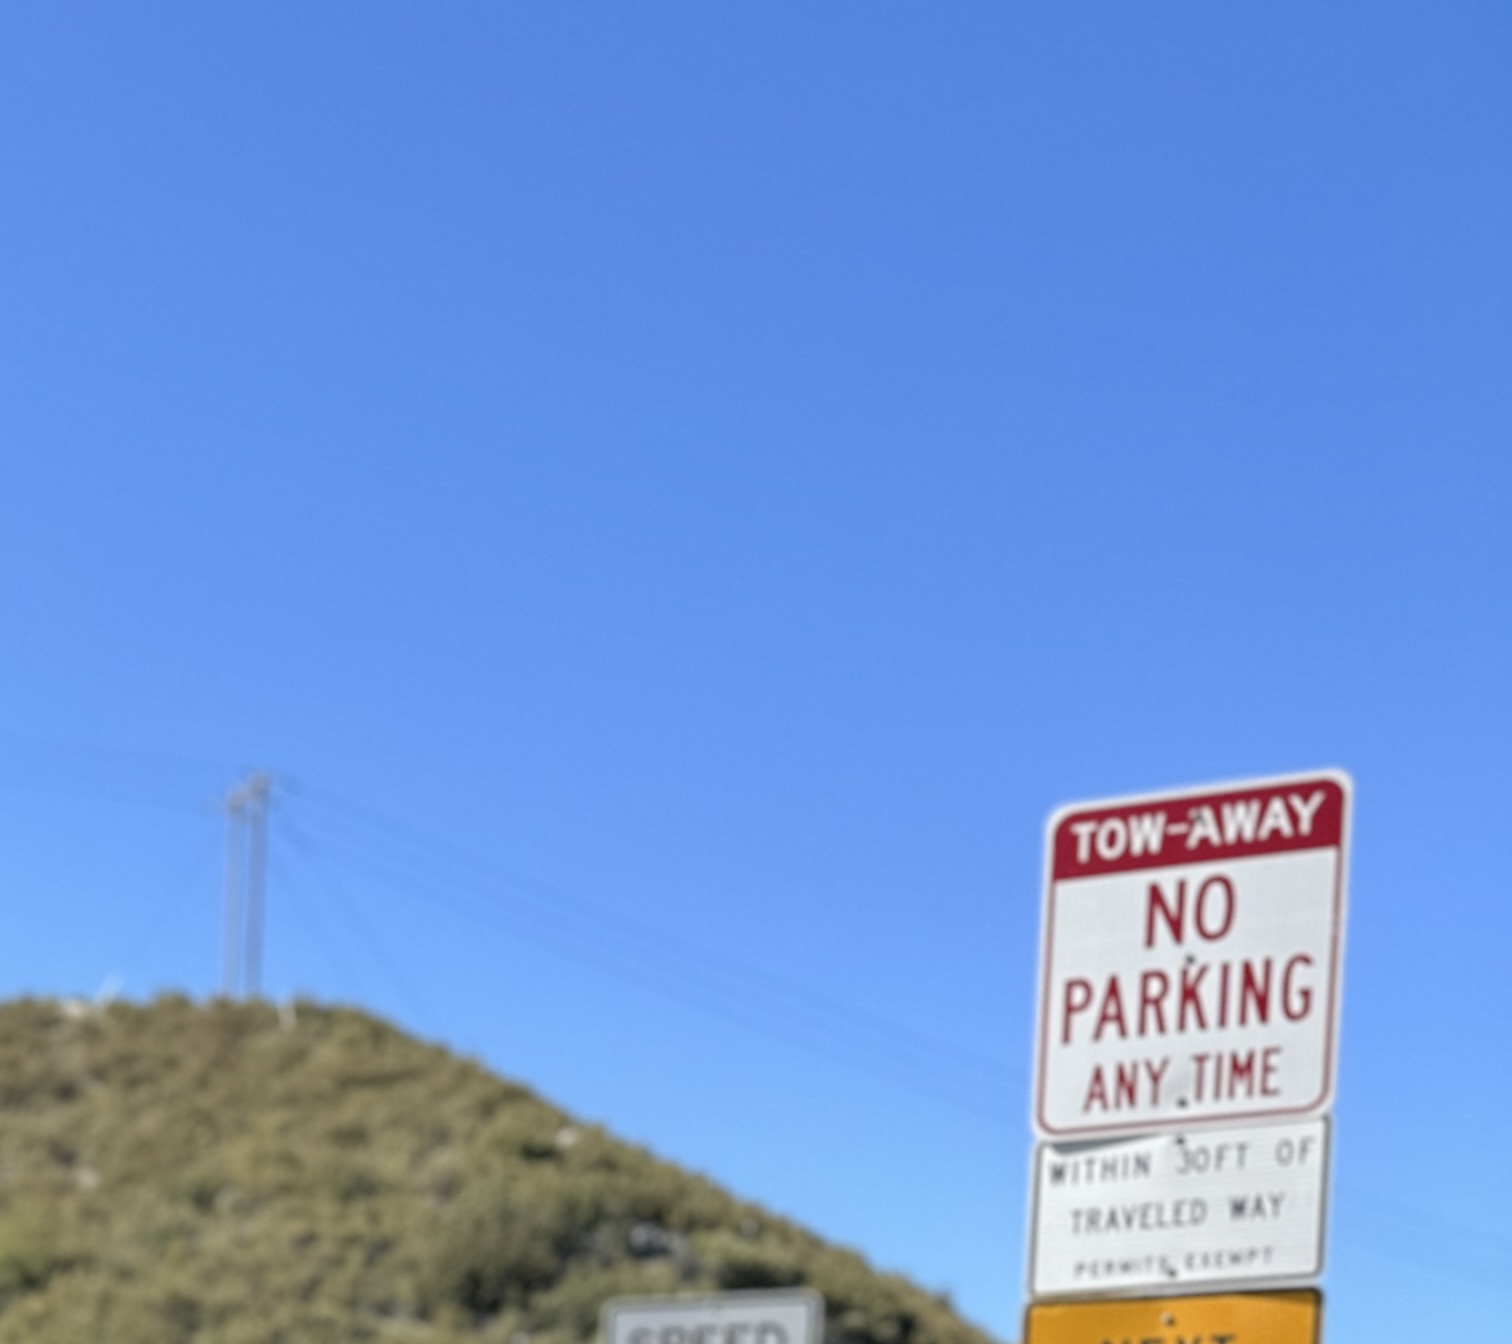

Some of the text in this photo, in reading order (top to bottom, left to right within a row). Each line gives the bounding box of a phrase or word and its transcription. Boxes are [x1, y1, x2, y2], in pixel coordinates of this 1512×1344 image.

[1070, 791, 1325, 864] TOW-AWAY
[1144, 873, 1236, 949] NO
[1061, 953, 1315, 1046] PARKING
[1083, 1047, 1283, 1114] ANY TIME
[1048, 1152, 1152, 1186] WITHIN
[1275, 1136, 1316, 1168] OF
[1069, 1191, 1287, 1236] TRAVELED WAY
[1074, 1246, 1275, 1279] PERMITS EXEMPT
